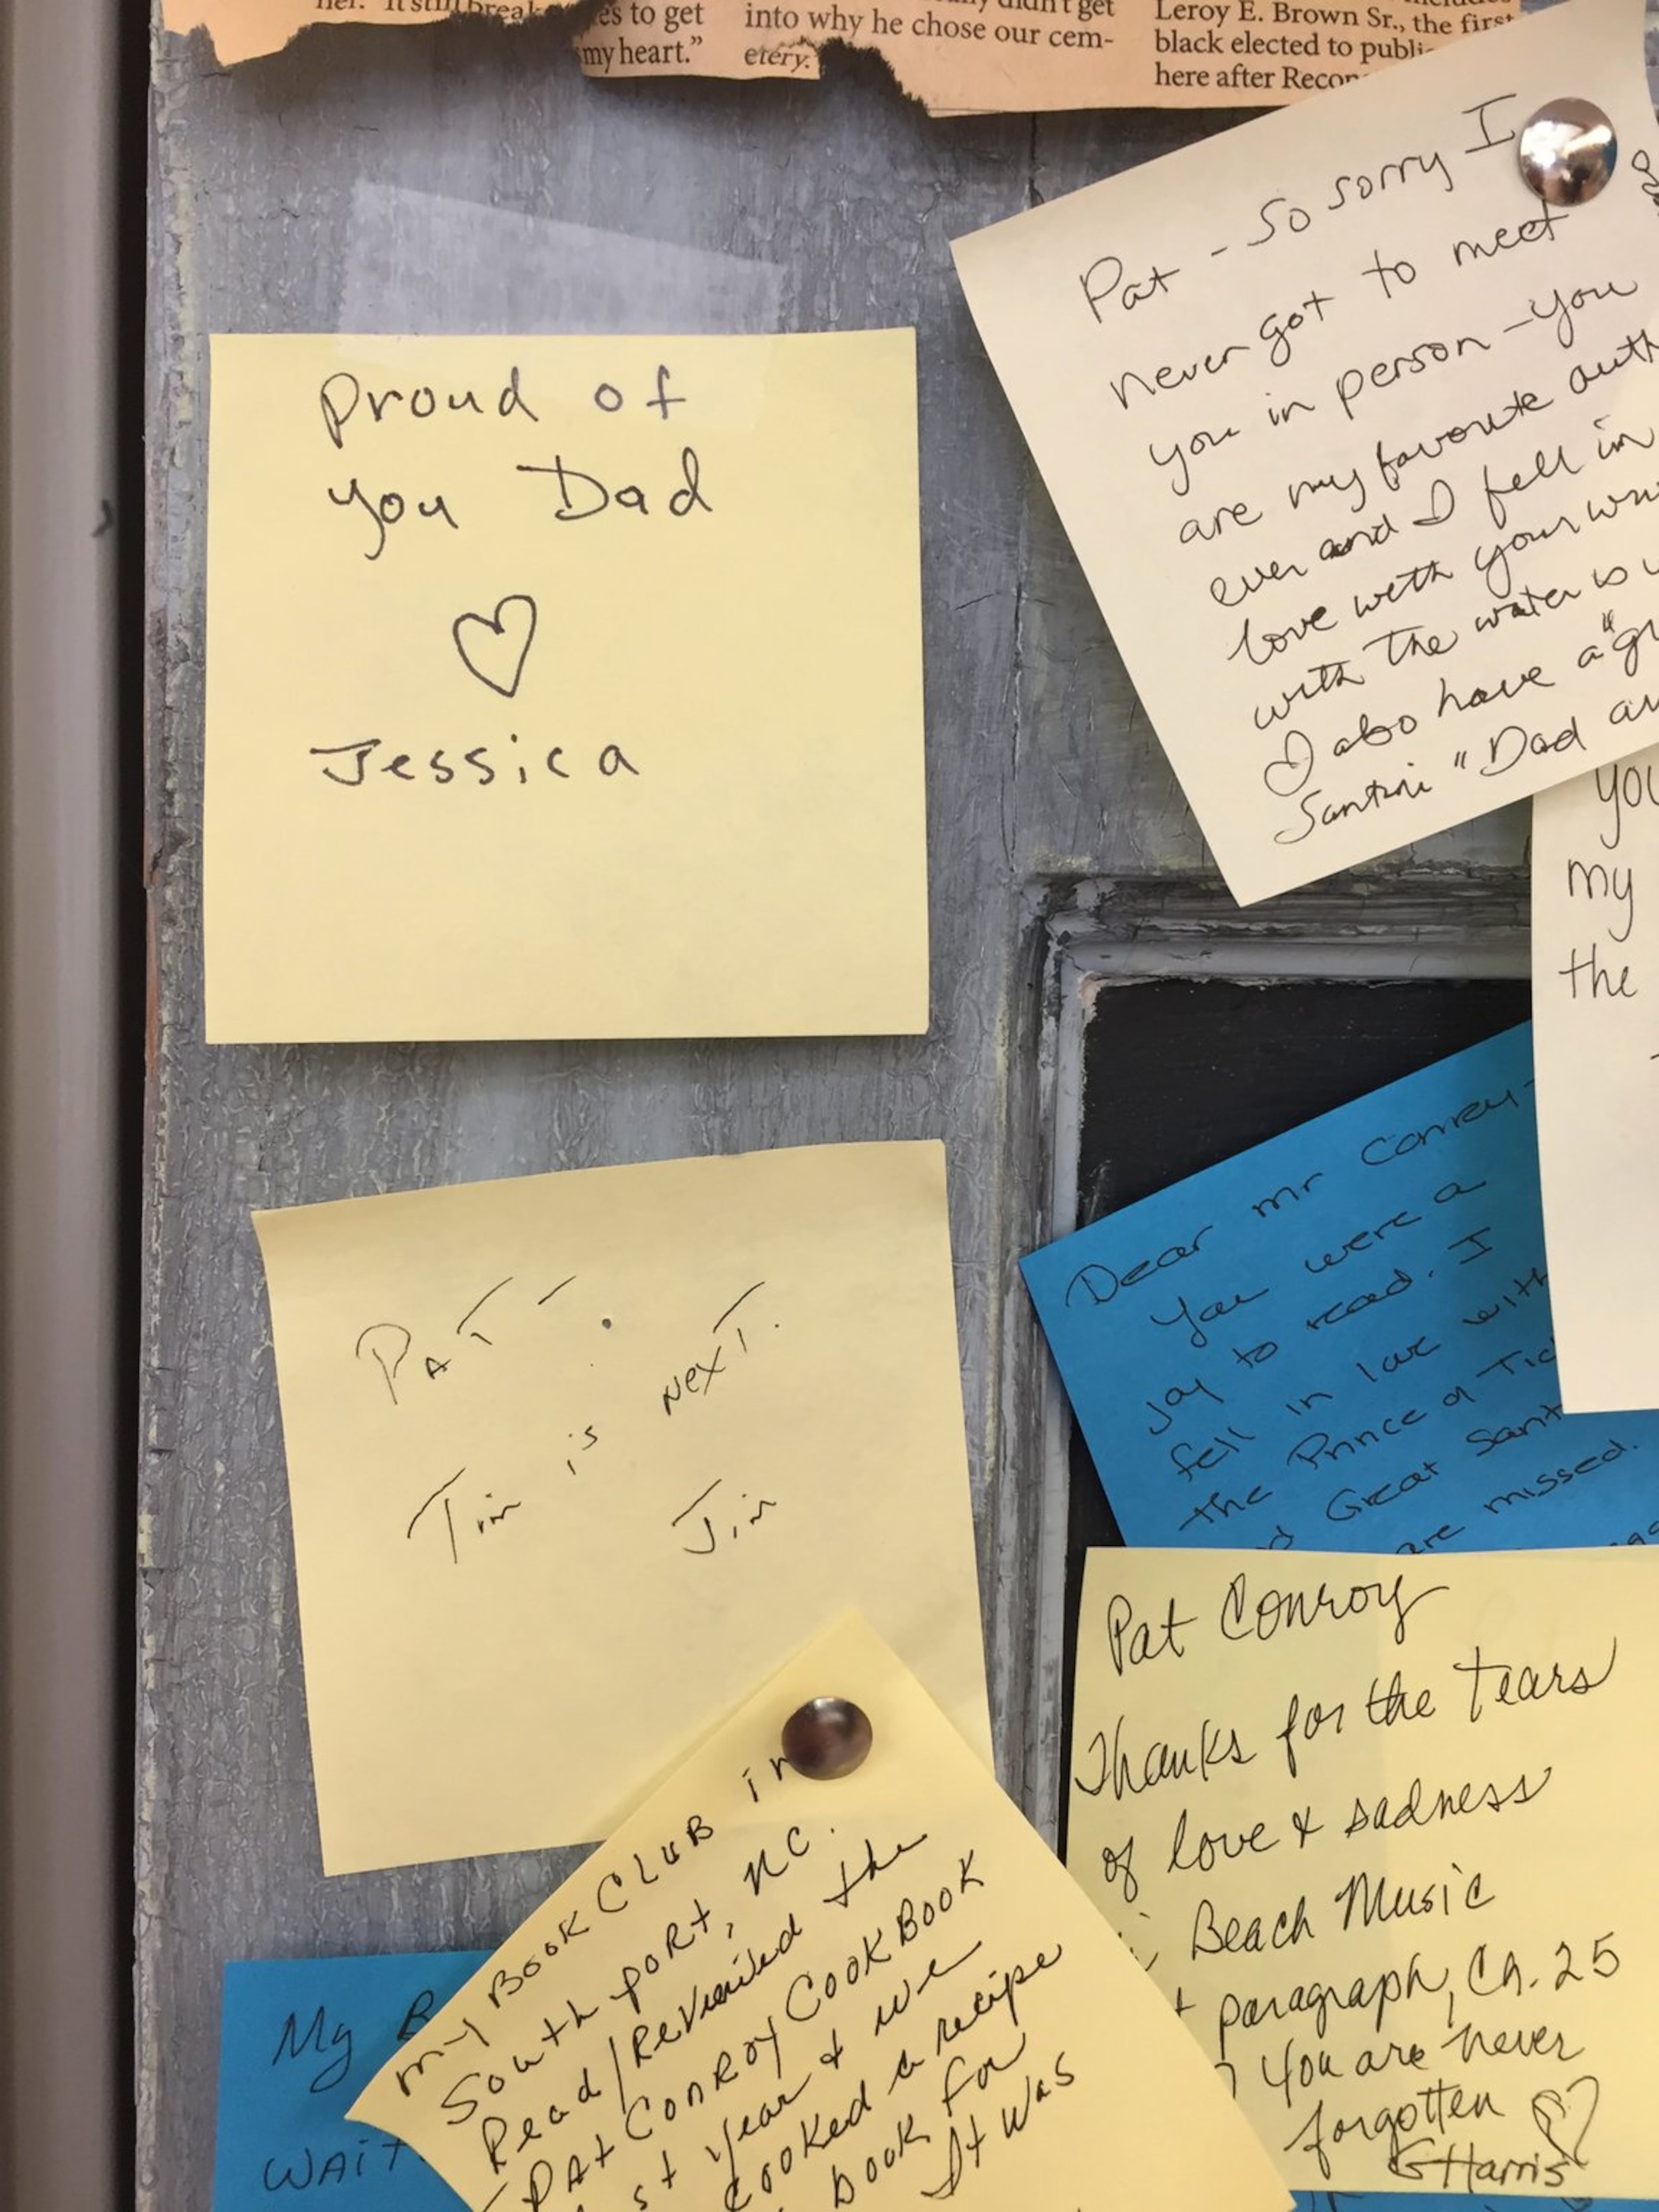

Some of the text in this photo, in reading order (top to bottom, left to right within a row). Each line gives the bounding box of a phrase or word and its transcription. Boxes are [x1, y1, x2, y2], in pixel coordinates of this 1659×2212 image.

[593, 5, 622, 25] es
[630, 2, 655, 25] to
[664, 2, 704, 33] get
[744, 5, 1114, 48] into why he chose our cem-
[1078, 0, 1116, 22] get
[1155, 0, 1229, 27] Leroy
[1239, 1, 1263, 23] E.
[1273, 4, 1358, 26] Brown
[1367, 6, 1405, 32] Sr.,
[1414, 13, 1452, 34] the
[1155, 29, 1434, 64] black elected to publi
[583, 44, 616, 73] my
[1155, 62, 1370, 89] here after Recon
[1080, 256, 1180, 324] Pat
[1328, 152, 1453, 210] sorry
[1462, 93, 1516, 154] I
[1110, 199, 1569, 410] never got to meet
[594, 364, 686, 420] of
[1149, 428, 1241, 496] you
[1265, 392, 1315, 426] in
[1337, 337, 1491, 420] person
[327, 447, 712, 561] you Dad
[1179, 503, 1262, 543] are
[1289, 468, 1366, 513] my
[1377, 391, 1554, 491] favorite
[1210, 414, 1654, 607] ever and I fell in
[1228, 606, 1338, 665] love
[1475, 515, 1580, 599] your
[1254, 660, 1365, 730] with
[1475, 585, 1581, 632] water
[1334, 714, 1417, 756] also
[1438, 666, 1556, 717] have
[1578, 645, 1605, 669] a
[309, 734, 639, 785] Jessica
[1479, 715, 1587, 777] Dad
[1567, 858, 1634, 942] my
[1558, 942, 1638, 999] the
[1065, 1225, 1213, 1308] Dear
[1305, 1211, 1422, 1273] were
[1433, 1181, 1487, 1203] a
[1232, 1341, 1278, 1368] to
[1447, 1226, 1494, 1265] I
[1170, 1426, 1255, 1482] fell
[1285, 1392, 1333, 1416] in
[1356, 1336, 1441, 1382] love
[1287, 1409, 1427, 1470] Prince
[1443, 1386, 1476, 1406] of
[407, 1467, 521, 1564] Tim
[565, 1424, 598, 1475] is
[1326, 1462, 1438, 1521] Great
[1107, 1572, 1450, 1677] Pat Conroy
[1074, 1714, 1257, 1800] Thanks
[1275, 1694, 1344, 1779] for
[1366, 1670, 1436, 1726] the
[823, 1834, 928, 1908] the
[1103, 1835, 1138, 1903] of
[1167, 1808, 1280, 1873] love
[1344, 1766, 1553, 1839] sadness
[1193, 1895, 1315, 1961] Beach
[1335, 1862, 1496, 1931] Music
[875, 1941, 982, 2036] we
[936, 1944, 1062, 2056] recipe
[1554, 1931, 1620, 1991] 25
[272, 2005, 353, 2093] My
[942, 2031, 1027, 2117] for
[1355, 2042, 1430, 2076] are
[1441, 2022, 1585, 2063] never
[1283, 2078, 1506, 2180] forgotten
